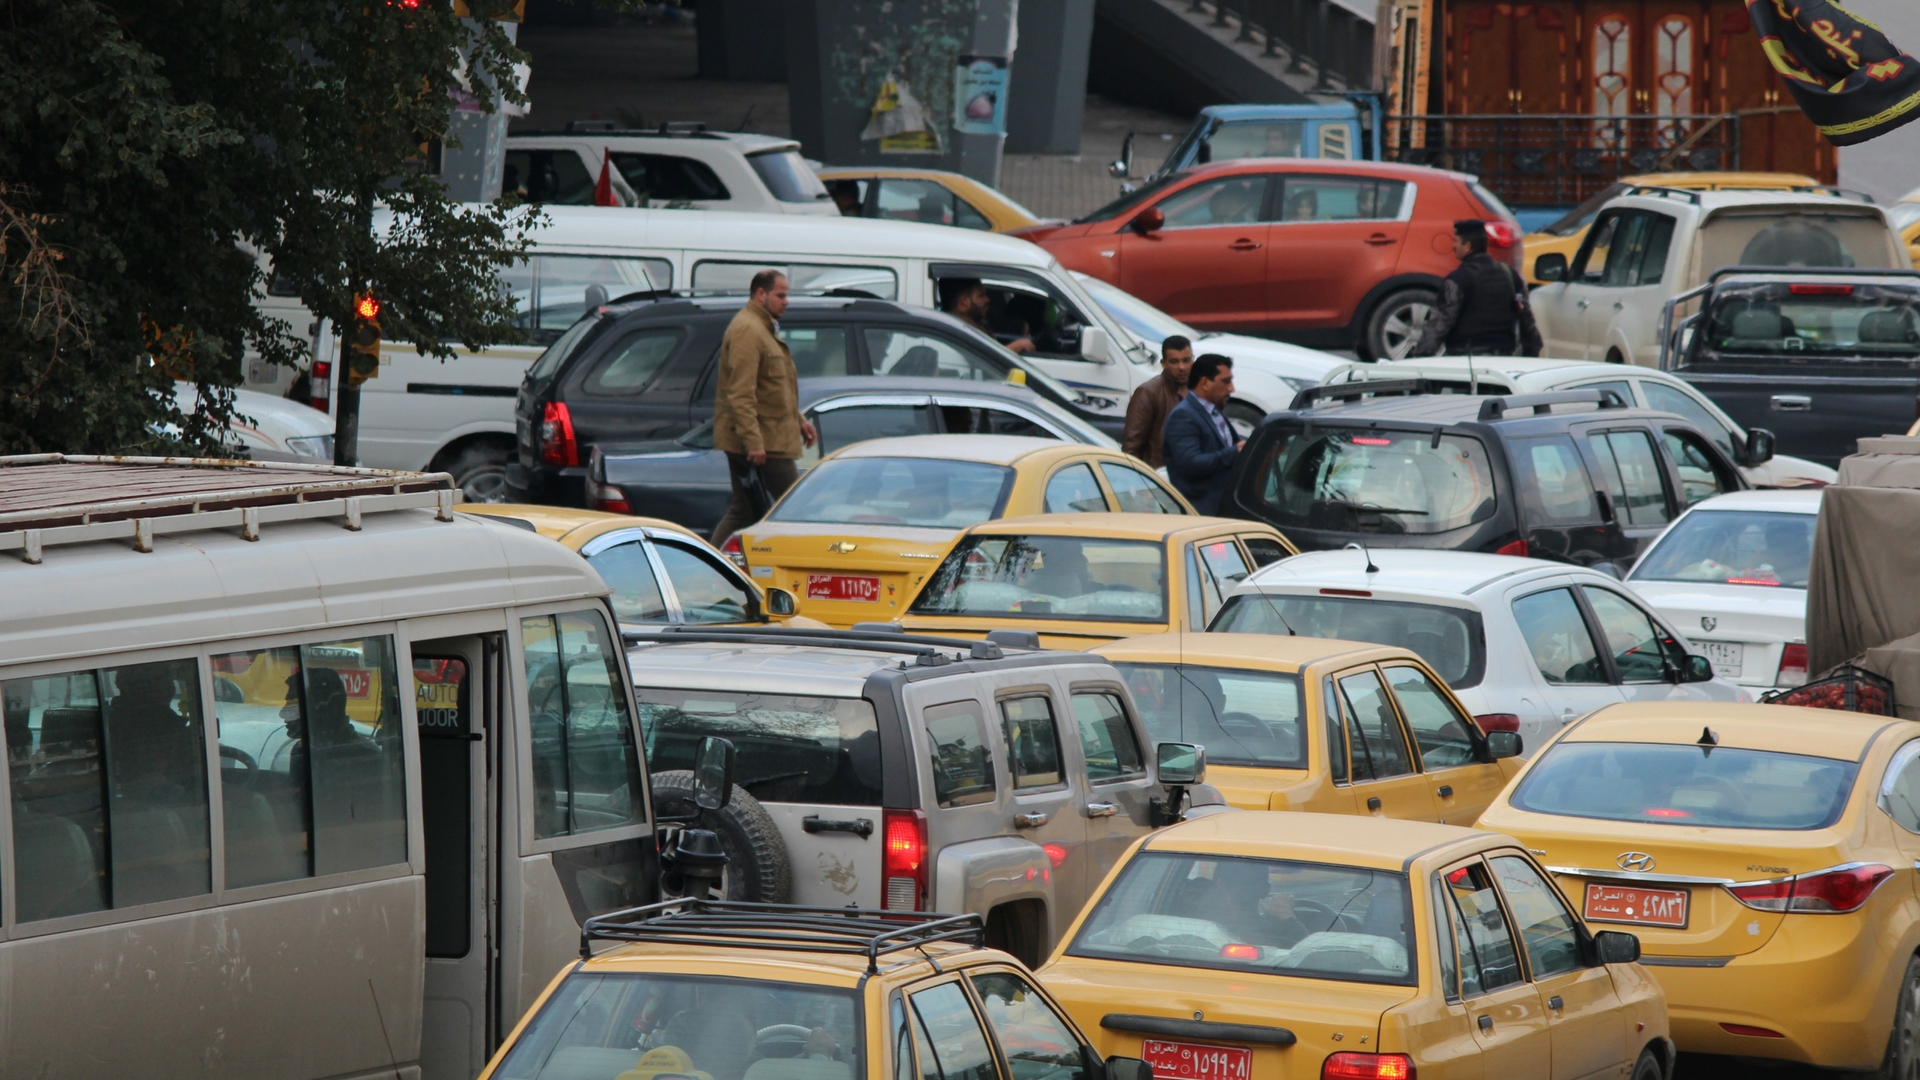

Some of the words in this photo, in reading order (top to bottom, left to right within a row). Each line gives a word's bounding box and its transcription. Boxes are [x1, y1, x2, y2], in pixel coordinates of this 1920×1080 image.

[416, 684, 458, 703] AUTO
[1592, 890, 1624, 901] العراق
[1593, 904, 1620, 915] بغداد
[1149, 1043, 1179, 1055] العراق
[1192, 1051, 1246, 1077] ١٥٩٩٠٨
